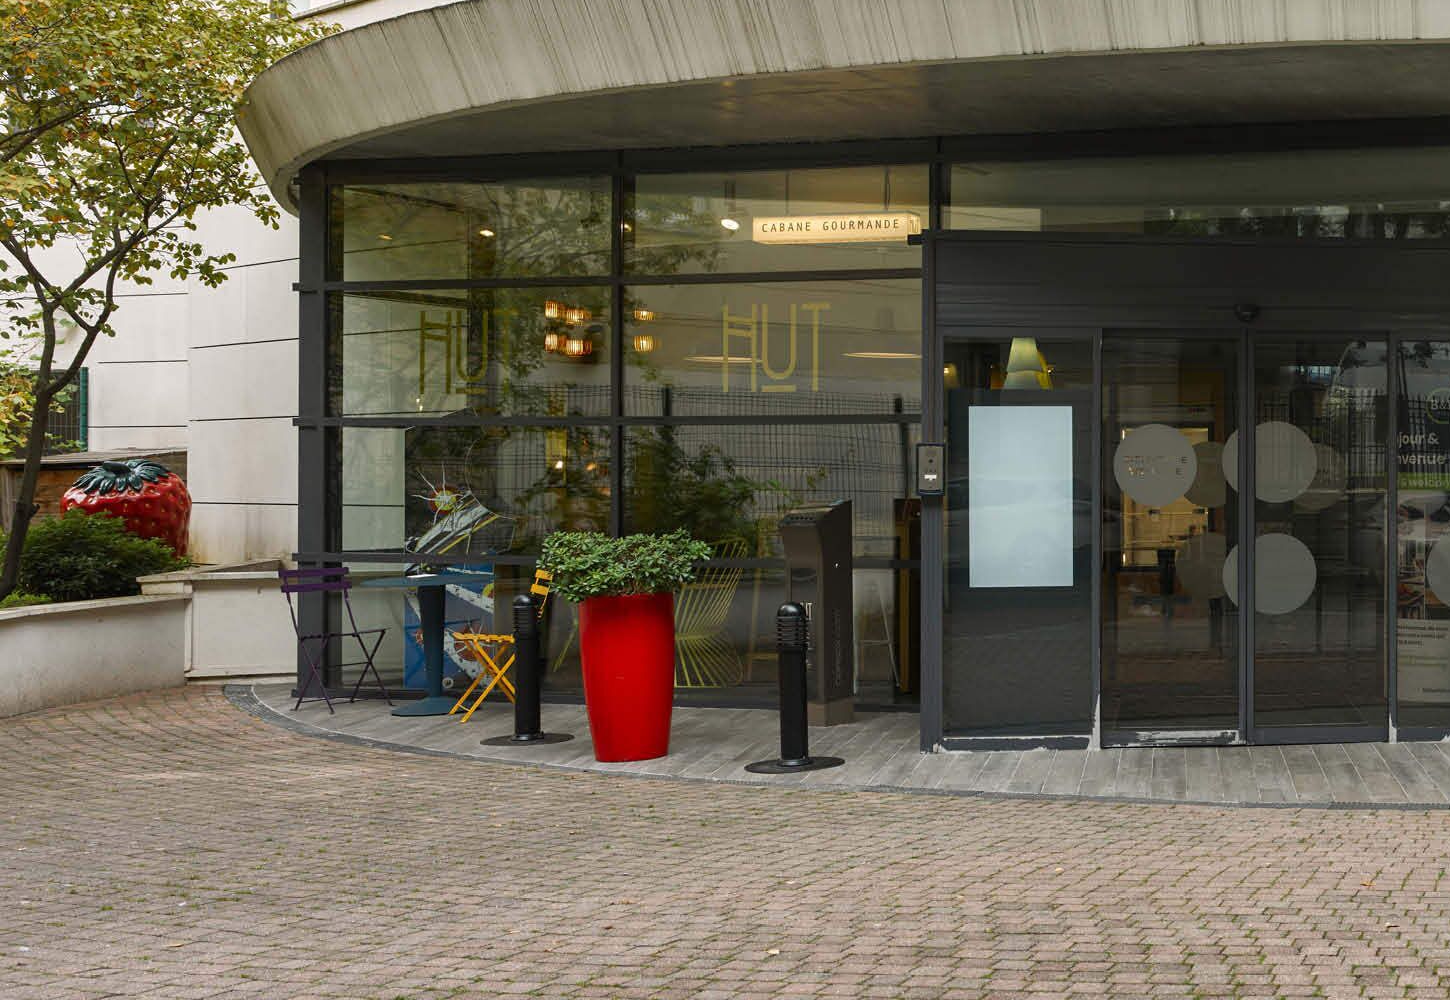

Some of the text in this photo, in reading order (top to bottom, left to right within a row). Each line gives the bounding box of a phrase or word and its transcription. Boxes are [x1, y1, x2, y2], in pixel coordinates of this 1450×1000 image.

[761, 222, 811, 233] CABANE
[822, 219, 900, 232] GOURMANDE
[723, 302, 831, 393] HUT
